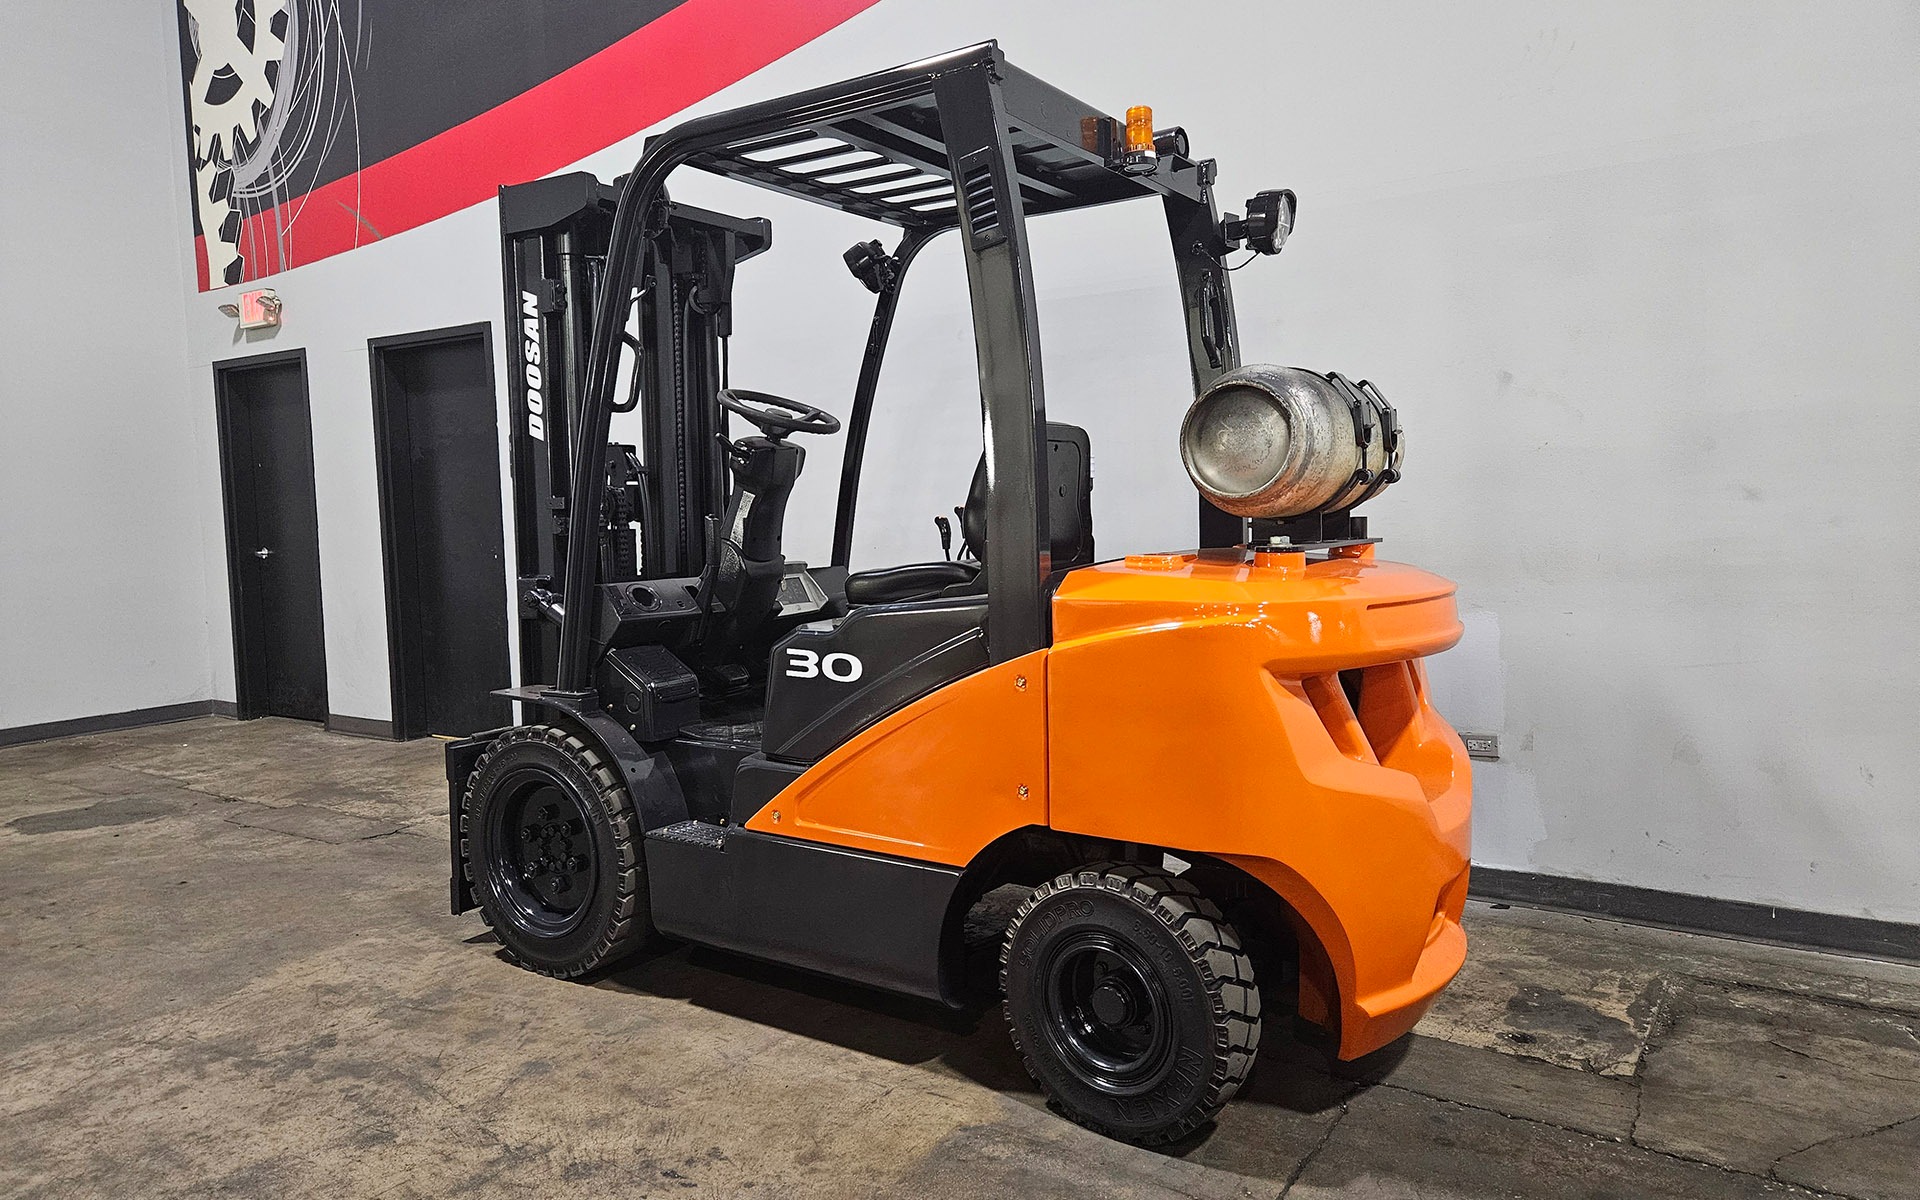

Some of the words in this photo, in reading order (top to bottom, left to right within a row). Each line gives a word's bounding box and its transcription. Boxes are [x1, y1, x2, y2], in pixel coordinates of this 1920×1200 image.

[522, 290, 545, 442] DOOSAN
[785, 648, 863, 683] 30
[557, 756, 604, 826] NEXEN
[1018, 899, 1095, 969] SOLIDPRO
